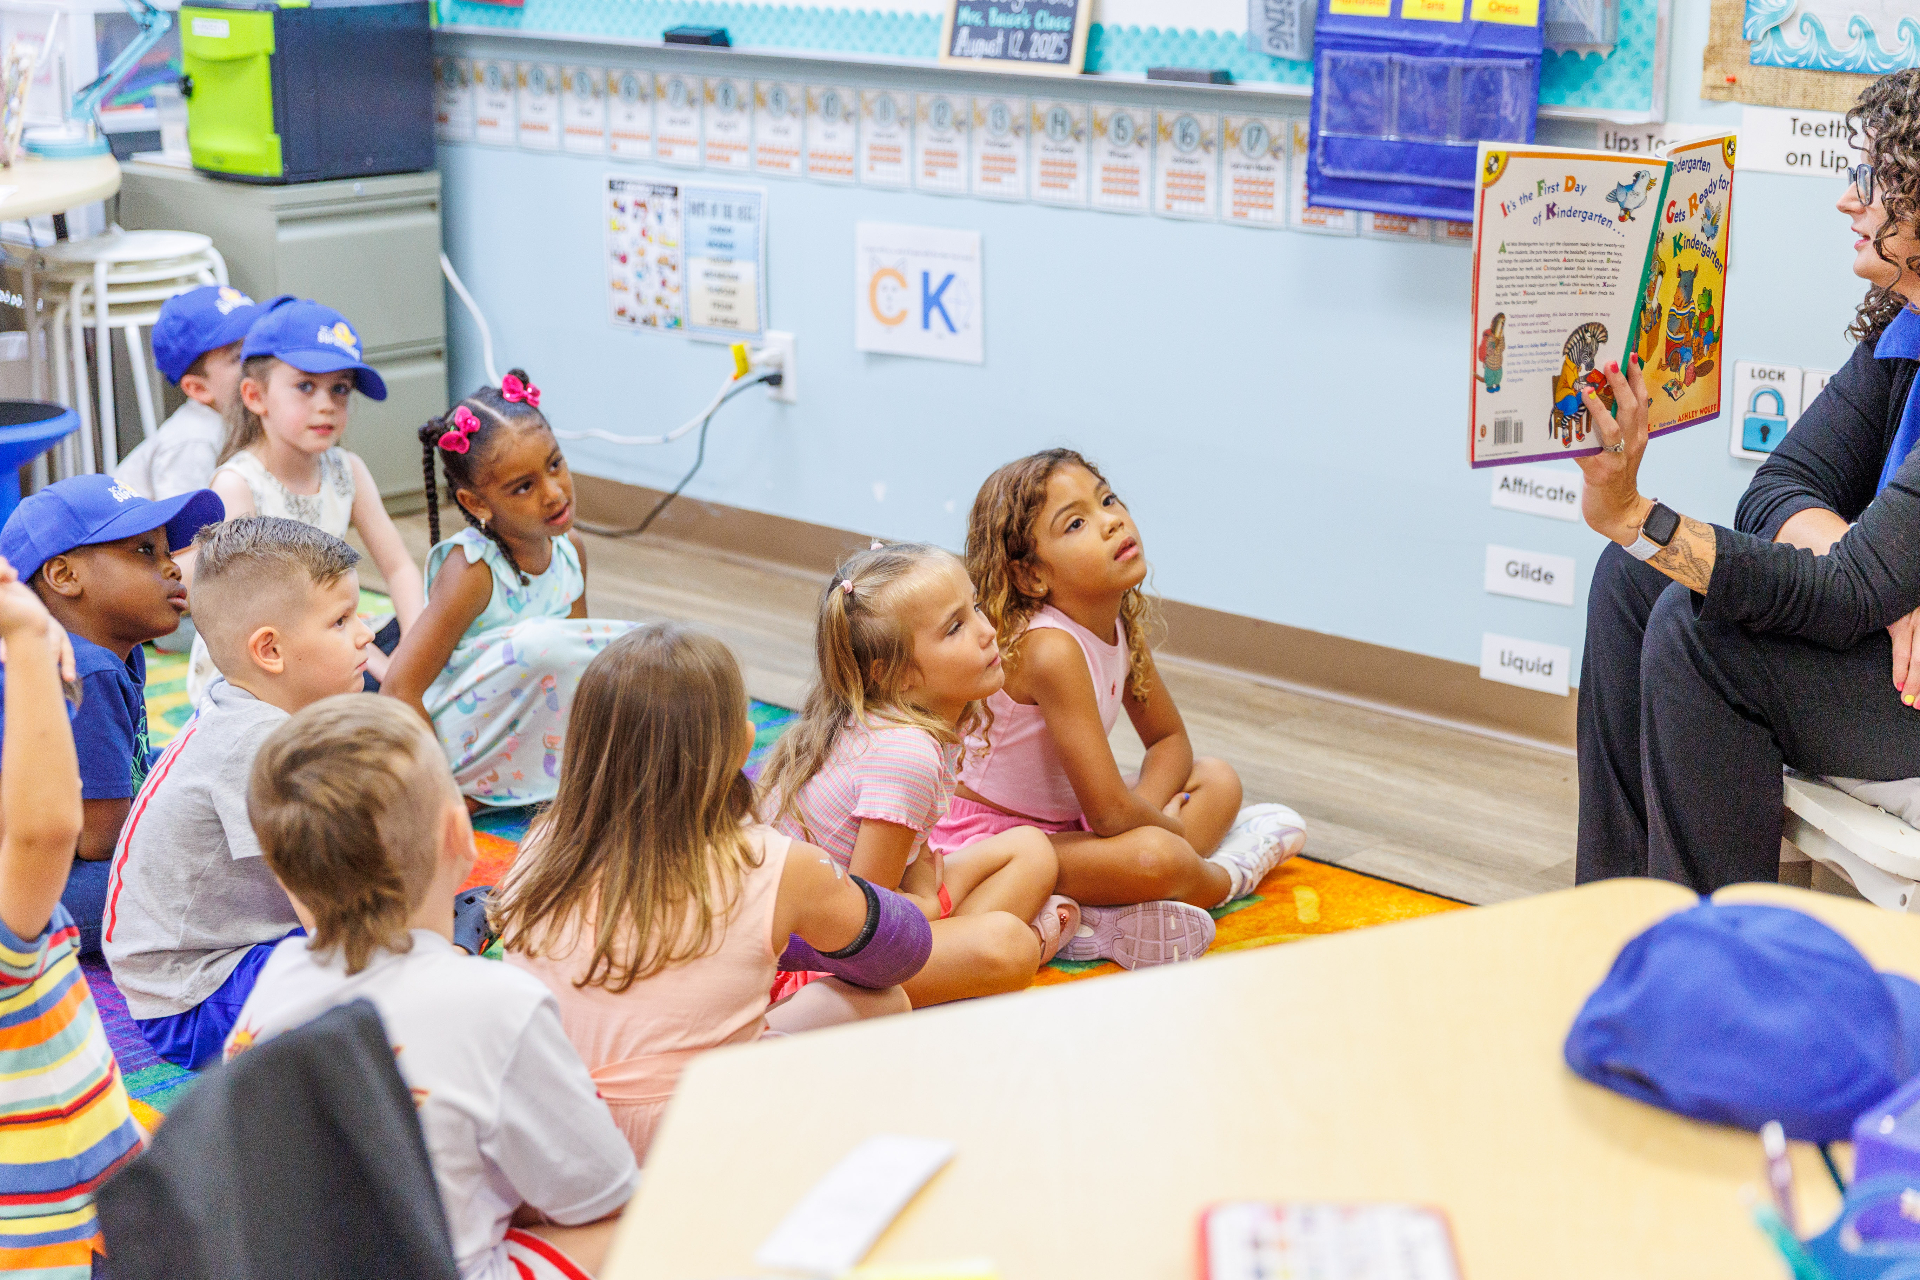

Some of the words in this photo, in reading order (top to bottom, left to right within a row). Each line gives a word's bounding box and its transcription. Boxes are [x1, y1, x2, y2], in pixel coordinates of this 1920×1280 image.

[952, 26, 1004, 61] August
[1029, 32, 1070, 60] 2025
[1790, 117, 1848, 138] Teeth
[1603, 131, 1639, 152] Lips
[1672, 157, 1711, 175] ndergarten
[1786, 150, 1812, 166] on
[1820, 150, 1849, 172] Lip
[1500, 200, 1516, 218] It's
[1519, 192, 1534, 206] the
[1536, 178, 1560, 198] First
[1562, 175, 1588, 196] Day
[1666, 200, 1686, 224] Gets
[1687, 178, 1718, 220] Ready
[1718, 174, 1730, 192] for
[1532, 210, 1542, 226] of
[1672, 232, 1724, 276] Kindergarten
[868, 267, 908, 326] C
[922, 270, 957, 334] K
[1751, 368, 1786, 381] LOCK
[1678, 410, 1698, 422] ASHLEY
[1700, 404, 1717, 416] WOLFF
[1499, 475, 1577, 504] Affricate
[1505, 560, 1555, 586] Glide
[1500, 649, 1554, 678] Liquid
